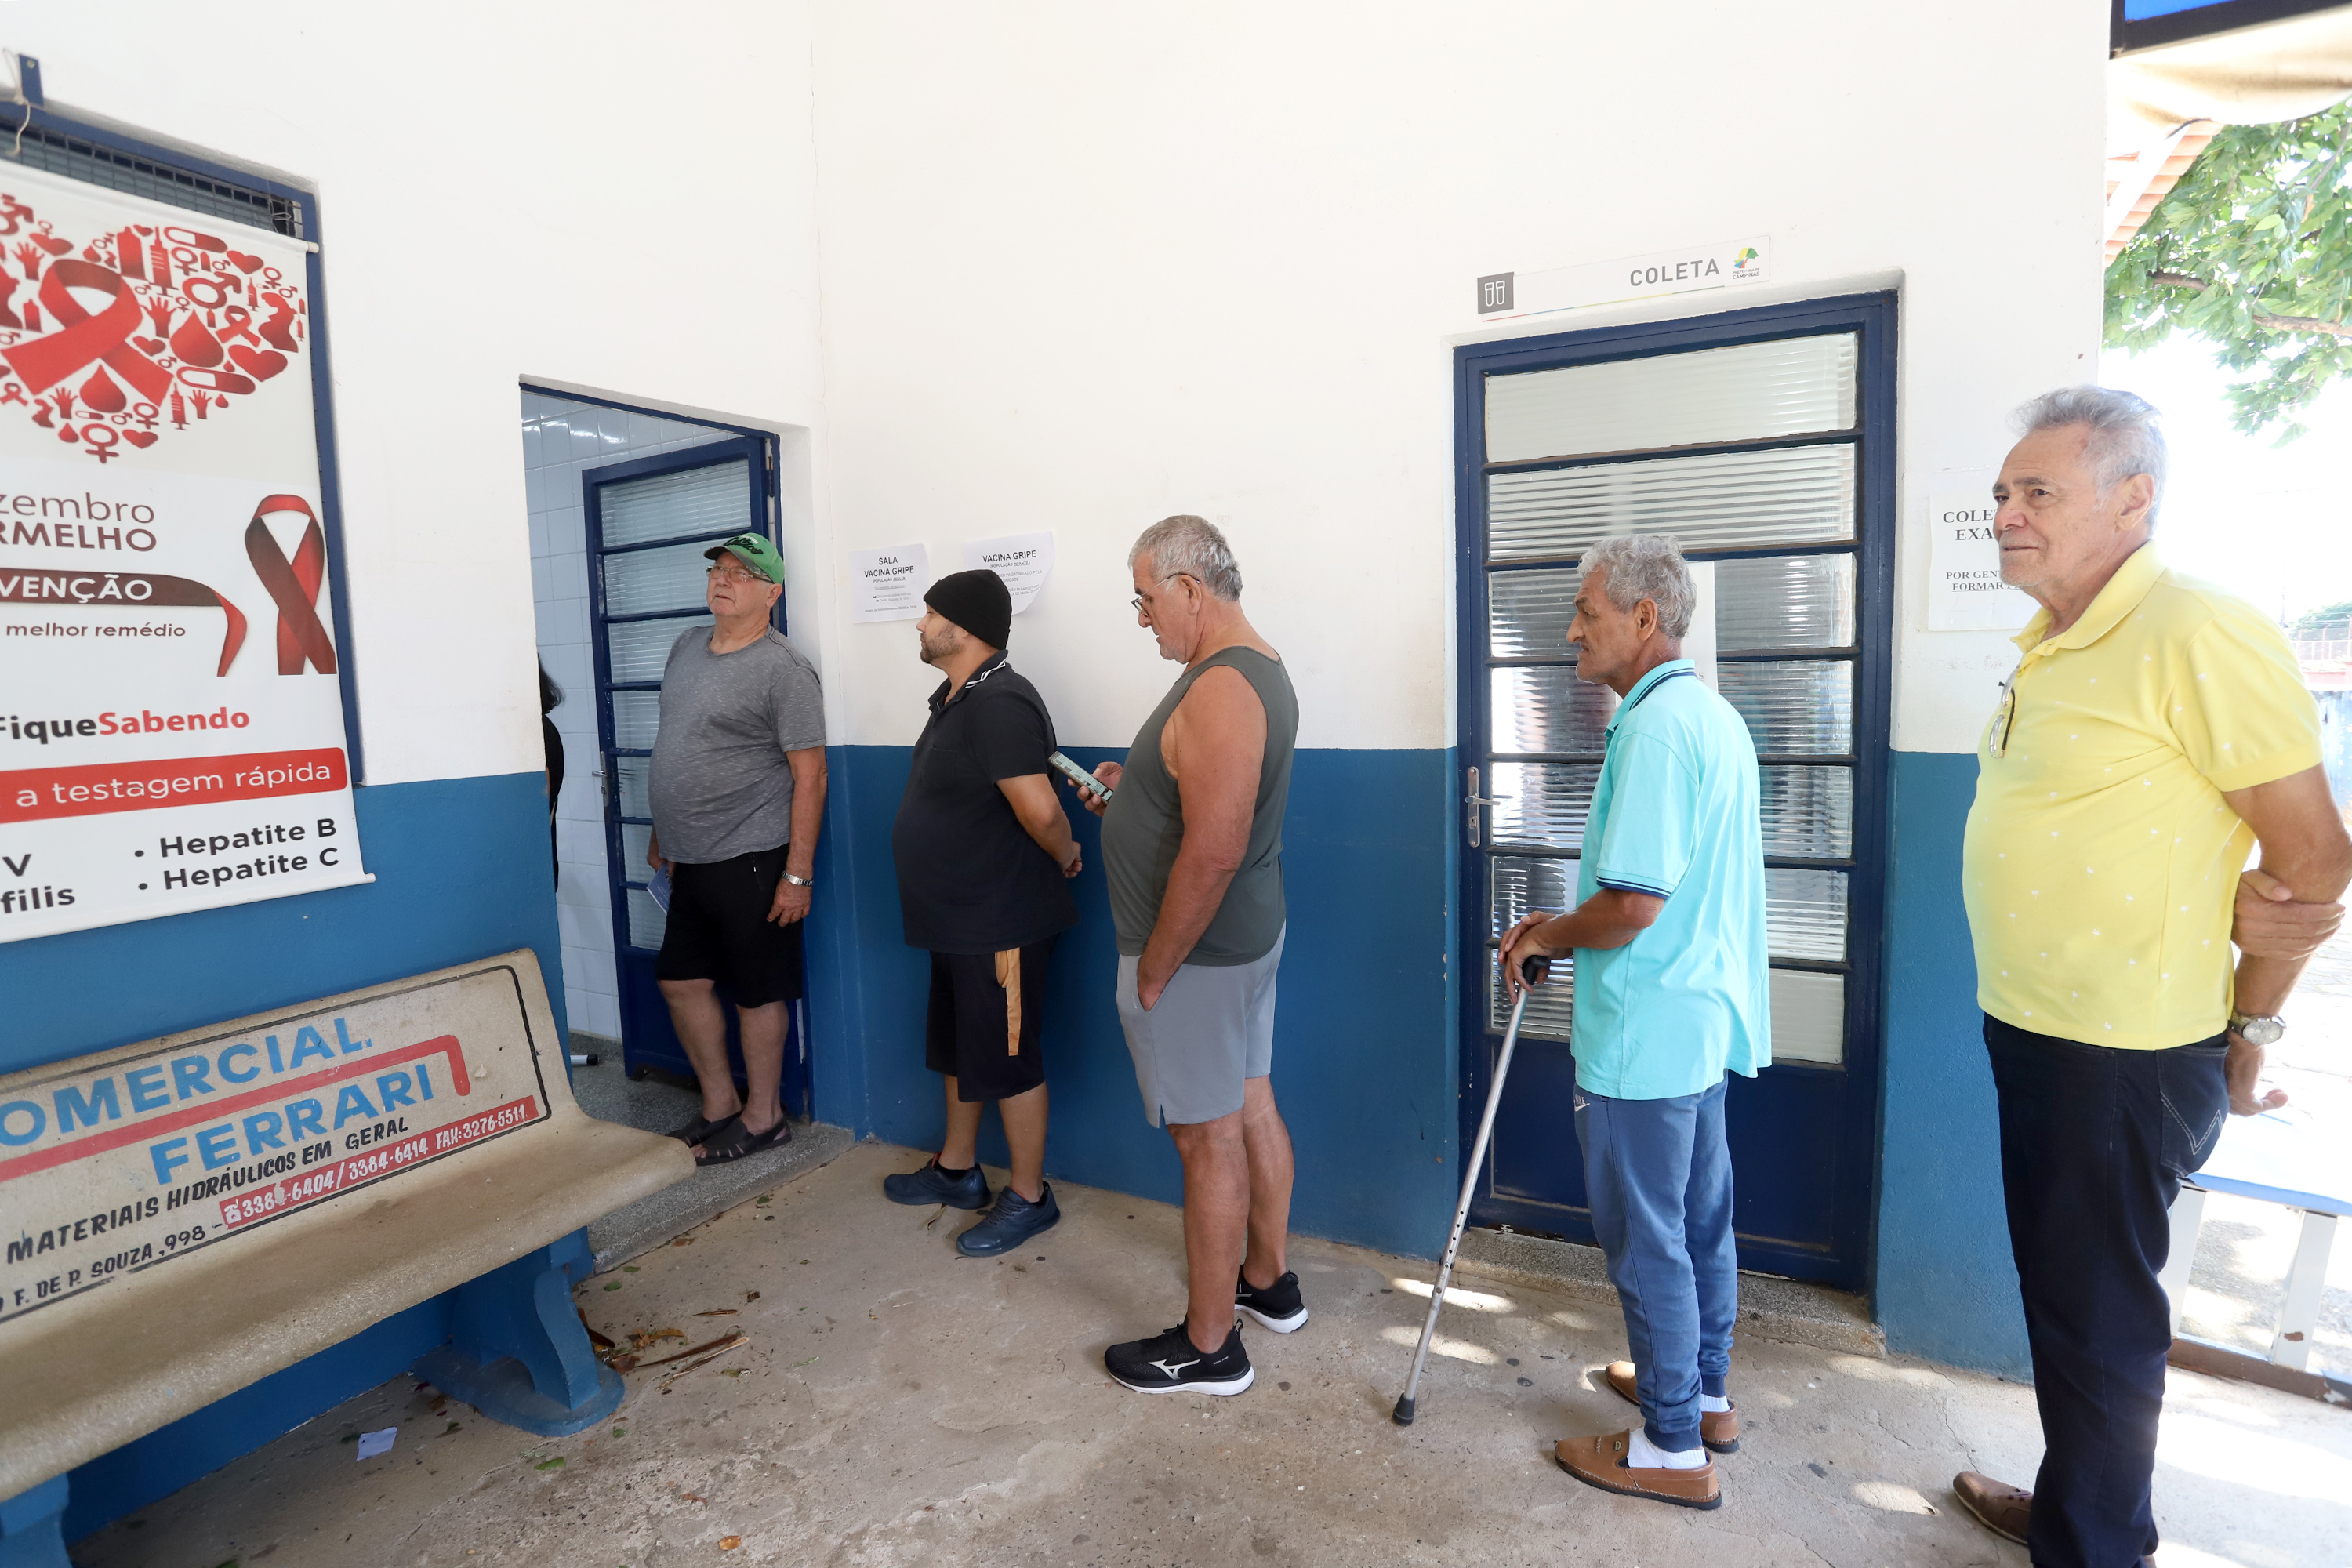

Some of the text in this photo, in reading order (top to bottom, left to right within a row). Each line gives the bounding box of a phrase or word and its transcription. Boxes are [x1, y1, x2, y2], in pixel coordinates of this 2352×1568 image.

[1630, 258, 1720, 287] COLETA
[1733, 271, 1760, 280] CAMPINAS
[1943, 509, 1997, 524] COLE
[1955, 528, 1995, 541] EXA
[879, 556, 898, 565] SALA
[982, 550, 1036, 563] VACINA GRIPE
[864, 565, 915, 578] VACINA GRIPE
[1946, 570, 1999, 579] POR GEN
[0, 573, 153, 604] VENÇÃO
[1952, 582, 2004, 591] FORMAR
[6, 622, 187, 637] melhor remédio
[16, 761, 331, 808] a testagem rápida
[160, 818, 337, 858] Hepatite B
[163, 848, 339, 890] Hepatite C
[0, 885, 76, 913] filis
[149, 1063, 434, 1185] FERRARI
[7, 1117, 408, 1265] MATERIAIS HIDRÁULICOS EM GERAL
[14, 1288, 30, 1306] F.
[37, 1276, 61, 1298] DE
[68, 1269, 82, 1287] P.
[91, 1243, 152, 1278] SOUZA
